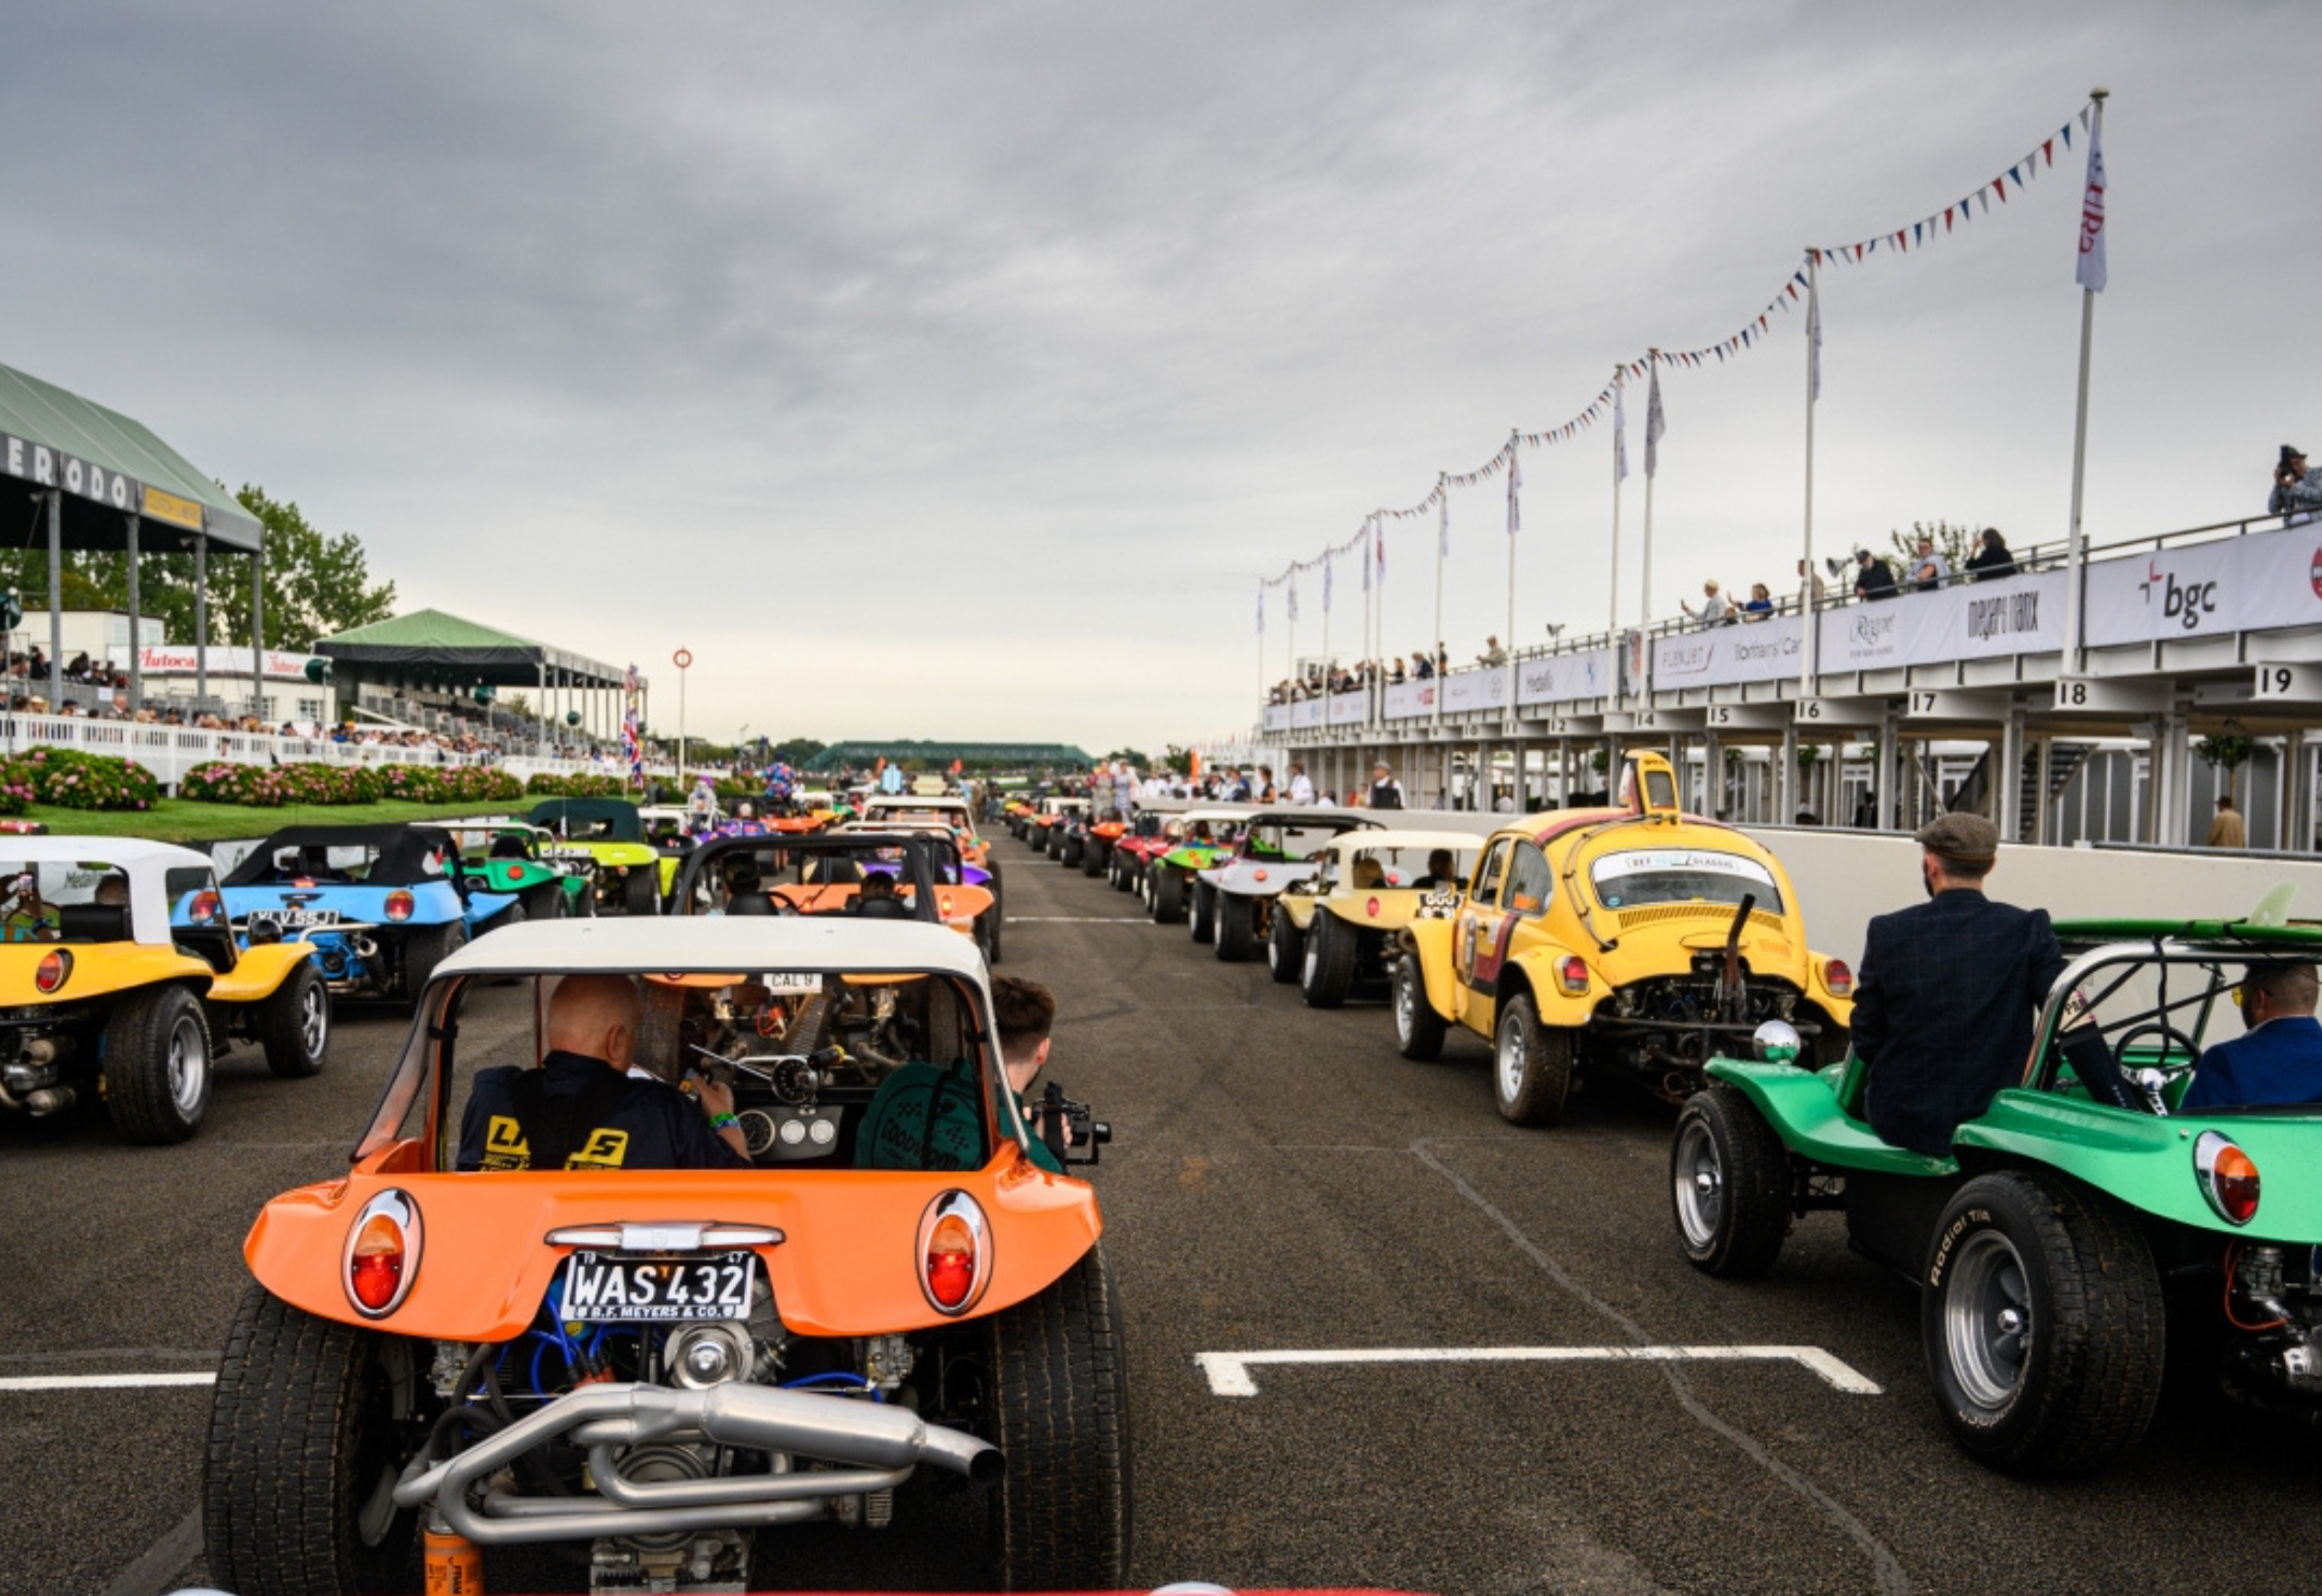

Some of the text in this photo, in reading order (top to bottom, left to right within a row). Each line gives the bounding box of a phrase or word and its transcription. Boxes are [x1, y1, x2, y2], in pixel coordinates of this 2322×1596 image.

[2164, 572, 2217, 629] bgc
[137, 647, 197, 669] Autoca
[2262, 667, 2292, 693] 19
[1913, 693, 1936, 711] 17
[2061, 683, 2086, 705] 18
[1637, 713, 1654, 726] 14
[1710, 707, 1729, 723] 15
[1800, 702, 1820, 718] 16
[1551, 719, 1565, 733] 12
[1930, 1216, 1967, 1287] Radial
[575, 1266, 743, 1304] WAS 432
[621, 1307, 679, 1317] MEYERS
[681, 1307, 693, 1317] &
[697, 1307, 721, 1317] CO.
